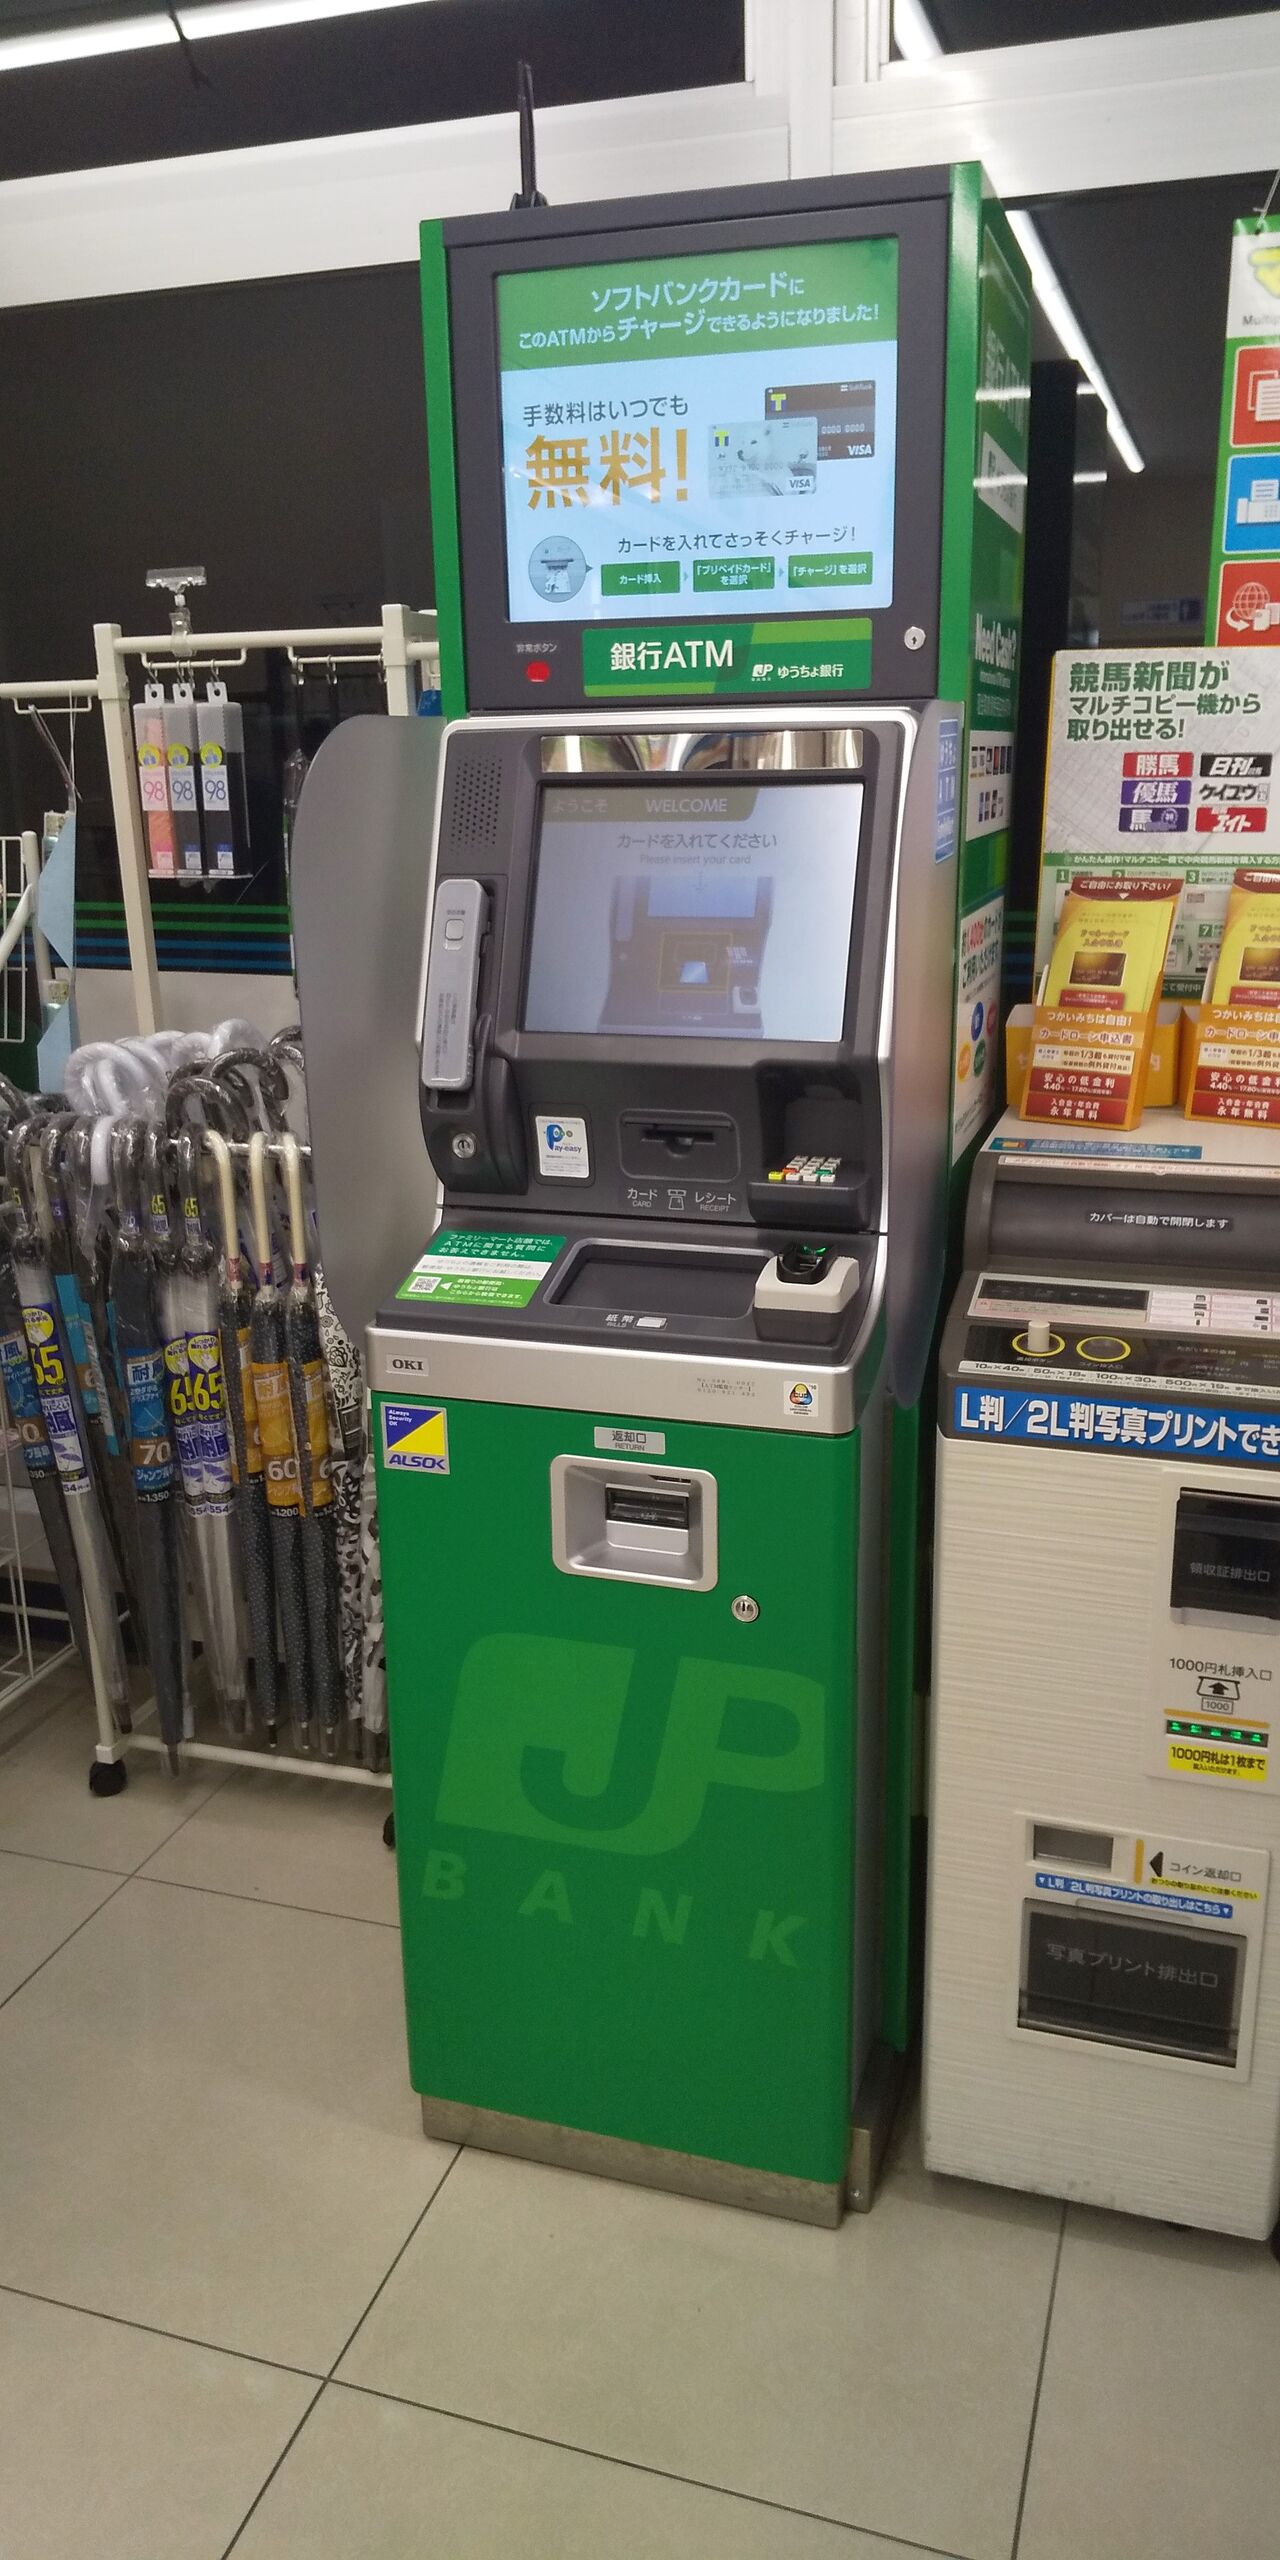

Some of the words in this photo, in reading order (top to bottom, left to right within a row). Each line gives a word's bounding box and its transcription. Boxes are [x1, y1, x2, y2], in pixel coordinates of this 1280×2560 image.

[592, 272, 805, 312] ソフトバンクカードに
[519, 304, 880, 350] このATMからチャージできるようになりました!
[523, 395, 689, 428] 手数料はいつでも
[847, 444, 873, 456] VISA
[525, 426, 689, 510] 無料!
[789, 479, 811, 489] VISA
[618, 525, 858, 555] カードを入れてさっそくチャージ!
[620, 573, 662, 585] カード挿入
[720, 574, 749, 586] を選択
[610, 639, 735, 671] 銀行ATM
[777, 663, 845, 679] ゆうちょ銀行
[1069, 660, 1230, 692] 競馬新聞が
[1069, 693, 1262, 716] マルチコピー機から
[1066, 718, 1186, 742] 取り出せる!
[1136, 754, 1180, 776] 勝馬
[143, 780, 165, 801] 98
[172, 780, 194, 801] 98
[204, 780, 227, 801] 98
[1132, 781, 1179, 804] 優馬
[1199, 783, 1258, 802] ケイユウ
[552, 798, 608, 814] ようこそ
[645, 798, 728, 813] WELCOME
[616, 832, 778, 849] カードを入れてください
[639, 853, 670, 865] Please
[672, 854, 698, 865] insert
[700, 855, 726, 867] your
[728, 853, 751, 865] card
[1080, 879, 1173, 892] ご自由にお取り下さい!
[1046, 1010, 1133, 1026] つかいみちは自由!
[1039, 1027, 1133, 1045] カードローン申込書
[1043, 1072, 1116, 1089] 安心の低金利
[1050, 1106, 1099, 1121] 永年無料
[1217, 1106, 1269, 1121] 永年無料
[627, 1186, 659, 1201] カード
[694, 1191, 737, 1206] レシート
[151, 1194, 167, 1215] 65
[184, 1197, 199, 1218] 65
[632, 1200, 652, 1208] CARD
[699, 1203, 731, 1213] RECEIPT
[1089, 1211, 1230, 1229] カバーは自動で開閉します
[392, 1358, 424, 1372] OKI
[193, 1372, 225, 1411] 65
[388, 1414, 413, 1424] Security
[611, 1429, 647, 1445] 返却口
[614, 1441, 646, 1452] RETURN
[139, 1440, 171, 1466] 70
[388, 1453, 447, 1472] ALSOK
[267, 1457, 299, 1482] 60
[1189, 1560, 1271, 1584] 領収証排出口
[1168, 1657, 1273, 1683] 1000円札挿入口
[1204, 1700, 1231, 1712] 1000
[1170, 1745, 1267, 1772] 1000円札は1枚まで
[1169, 1861, 1243, 1884] コイン返却口
[420, 1848, 811, 1968] BANK
[1044, 1942, 1219, 1989] 写真プリント排出口
